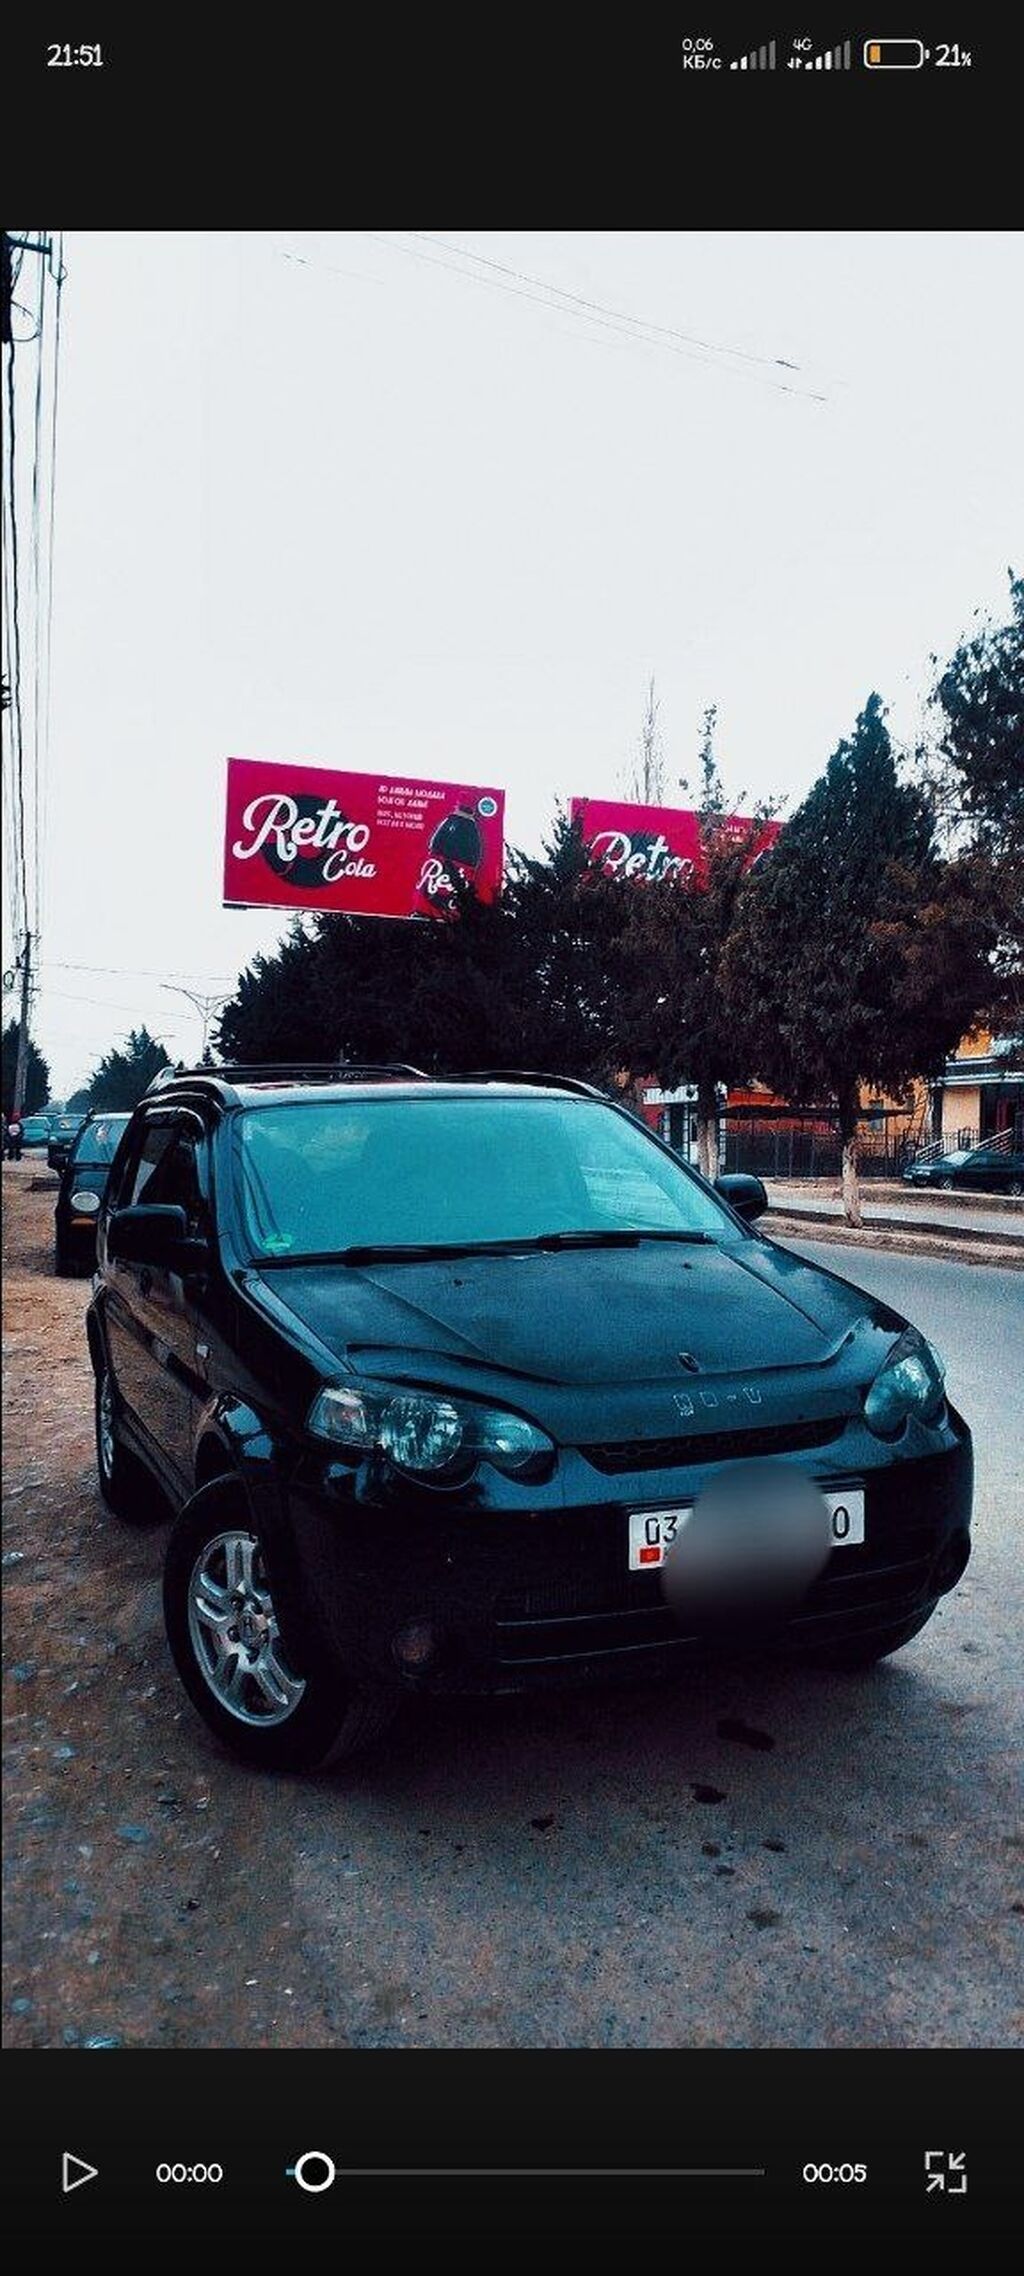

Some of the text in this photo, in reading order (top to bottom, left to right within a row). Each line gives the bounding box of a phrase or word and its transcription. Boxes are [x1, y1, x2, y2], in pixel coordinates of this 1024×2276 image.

[232, 794, 371, 862] Retro
[322, 849, 378, 882] Cola
[644, 1515, 679, 1545] 03
